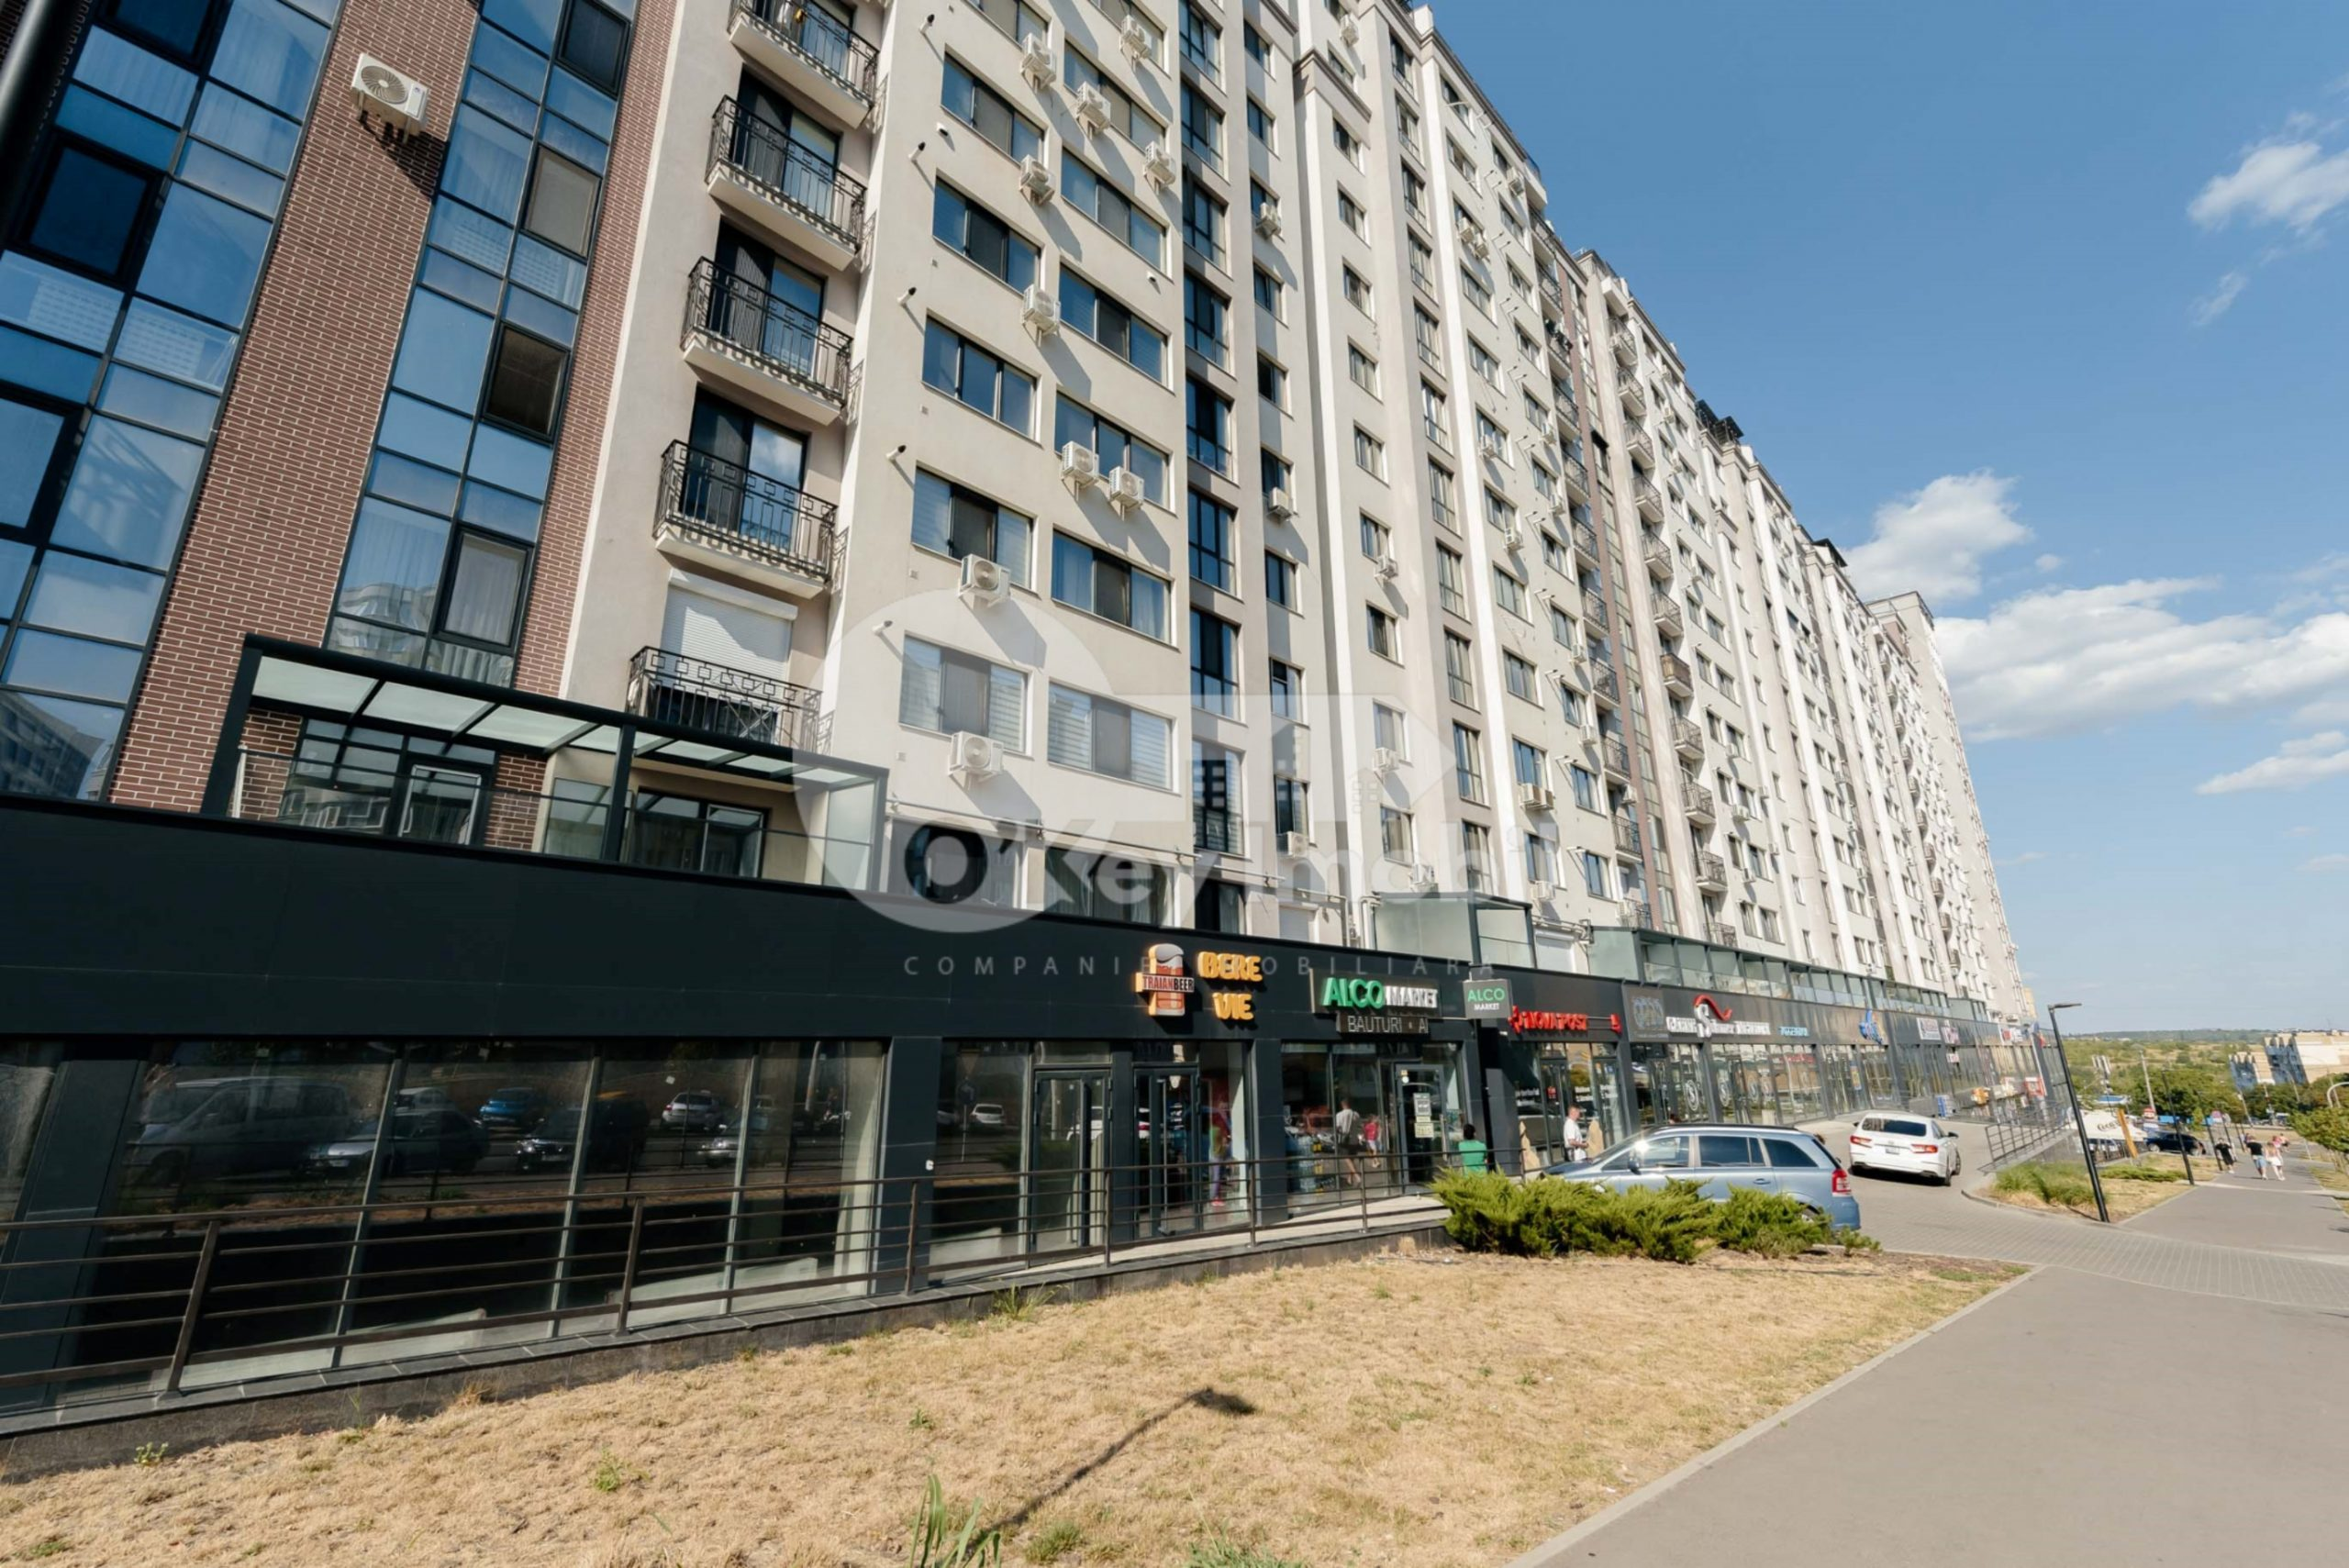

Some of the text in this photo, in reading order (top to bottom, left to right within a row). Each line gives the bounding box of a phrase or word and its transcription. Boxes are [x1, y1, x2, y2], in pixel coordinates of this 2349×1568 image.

[1197, 951, 1264, 982] BERE
[1322, 977, 1385, 1008] ALCO
[1468, 988, 1506, 1003] ALCO
[1212, 993, 1253, 1020] VIE
[1474, 1002, 1500, 1011] MARKET
[1348, 1015, 1403, 1033] BAUTURI
